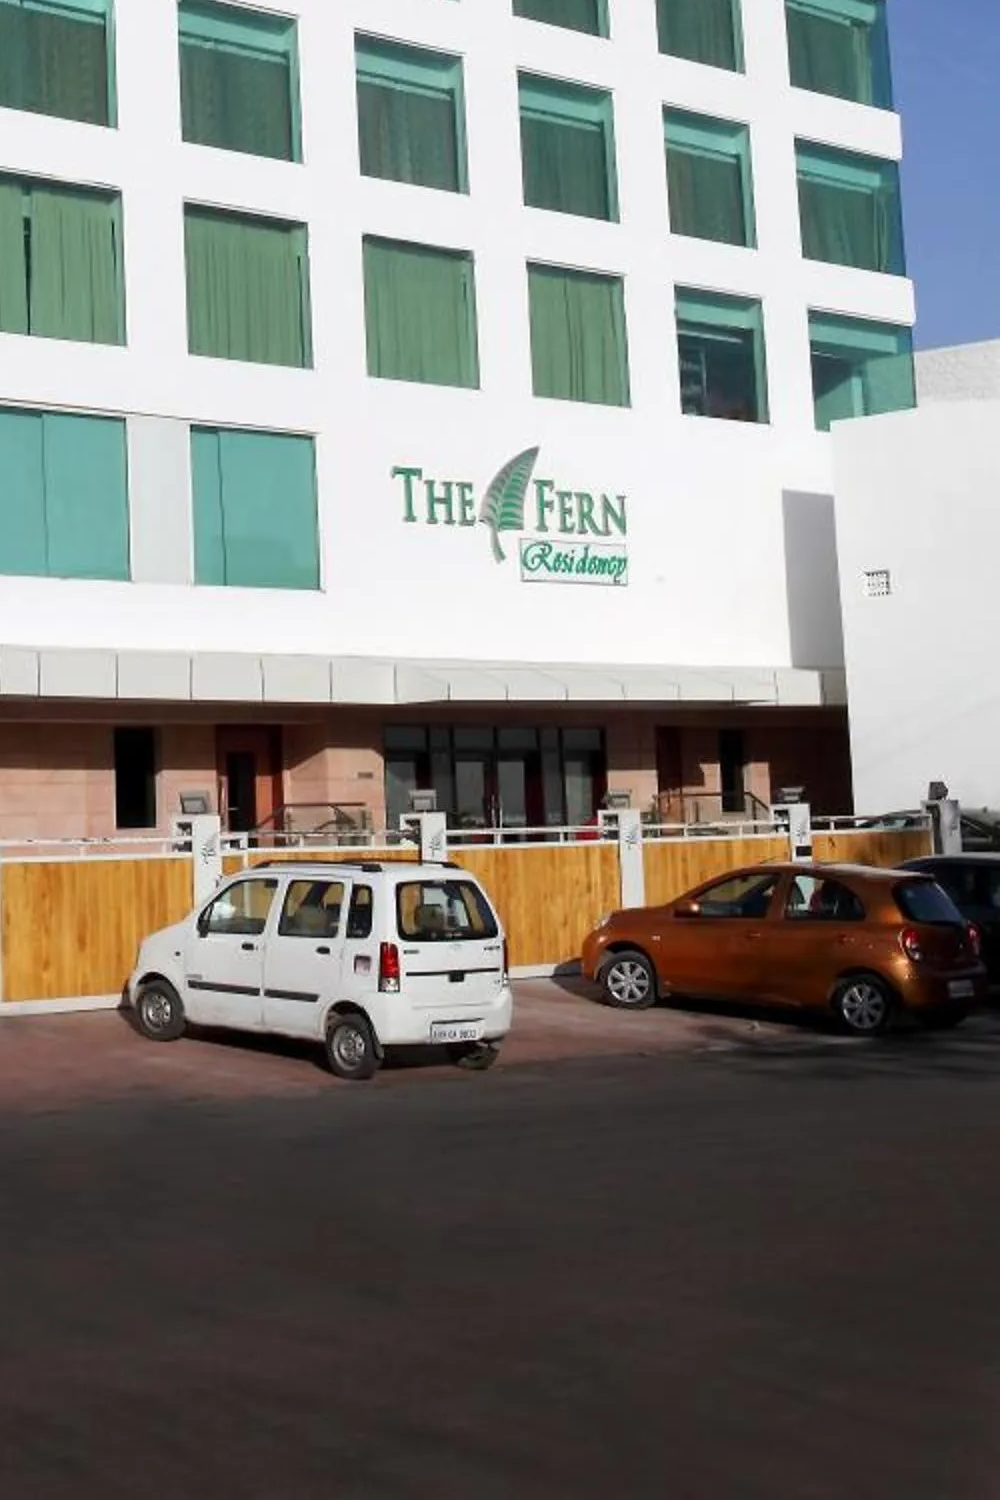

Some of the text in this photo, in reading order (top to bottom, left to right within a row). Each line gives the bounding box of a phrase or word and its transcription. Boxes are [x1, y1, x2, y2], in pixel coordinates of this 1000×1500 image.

[391, 466, 627, 536] THE FERN
[523, 541, 627, 583] Residency
